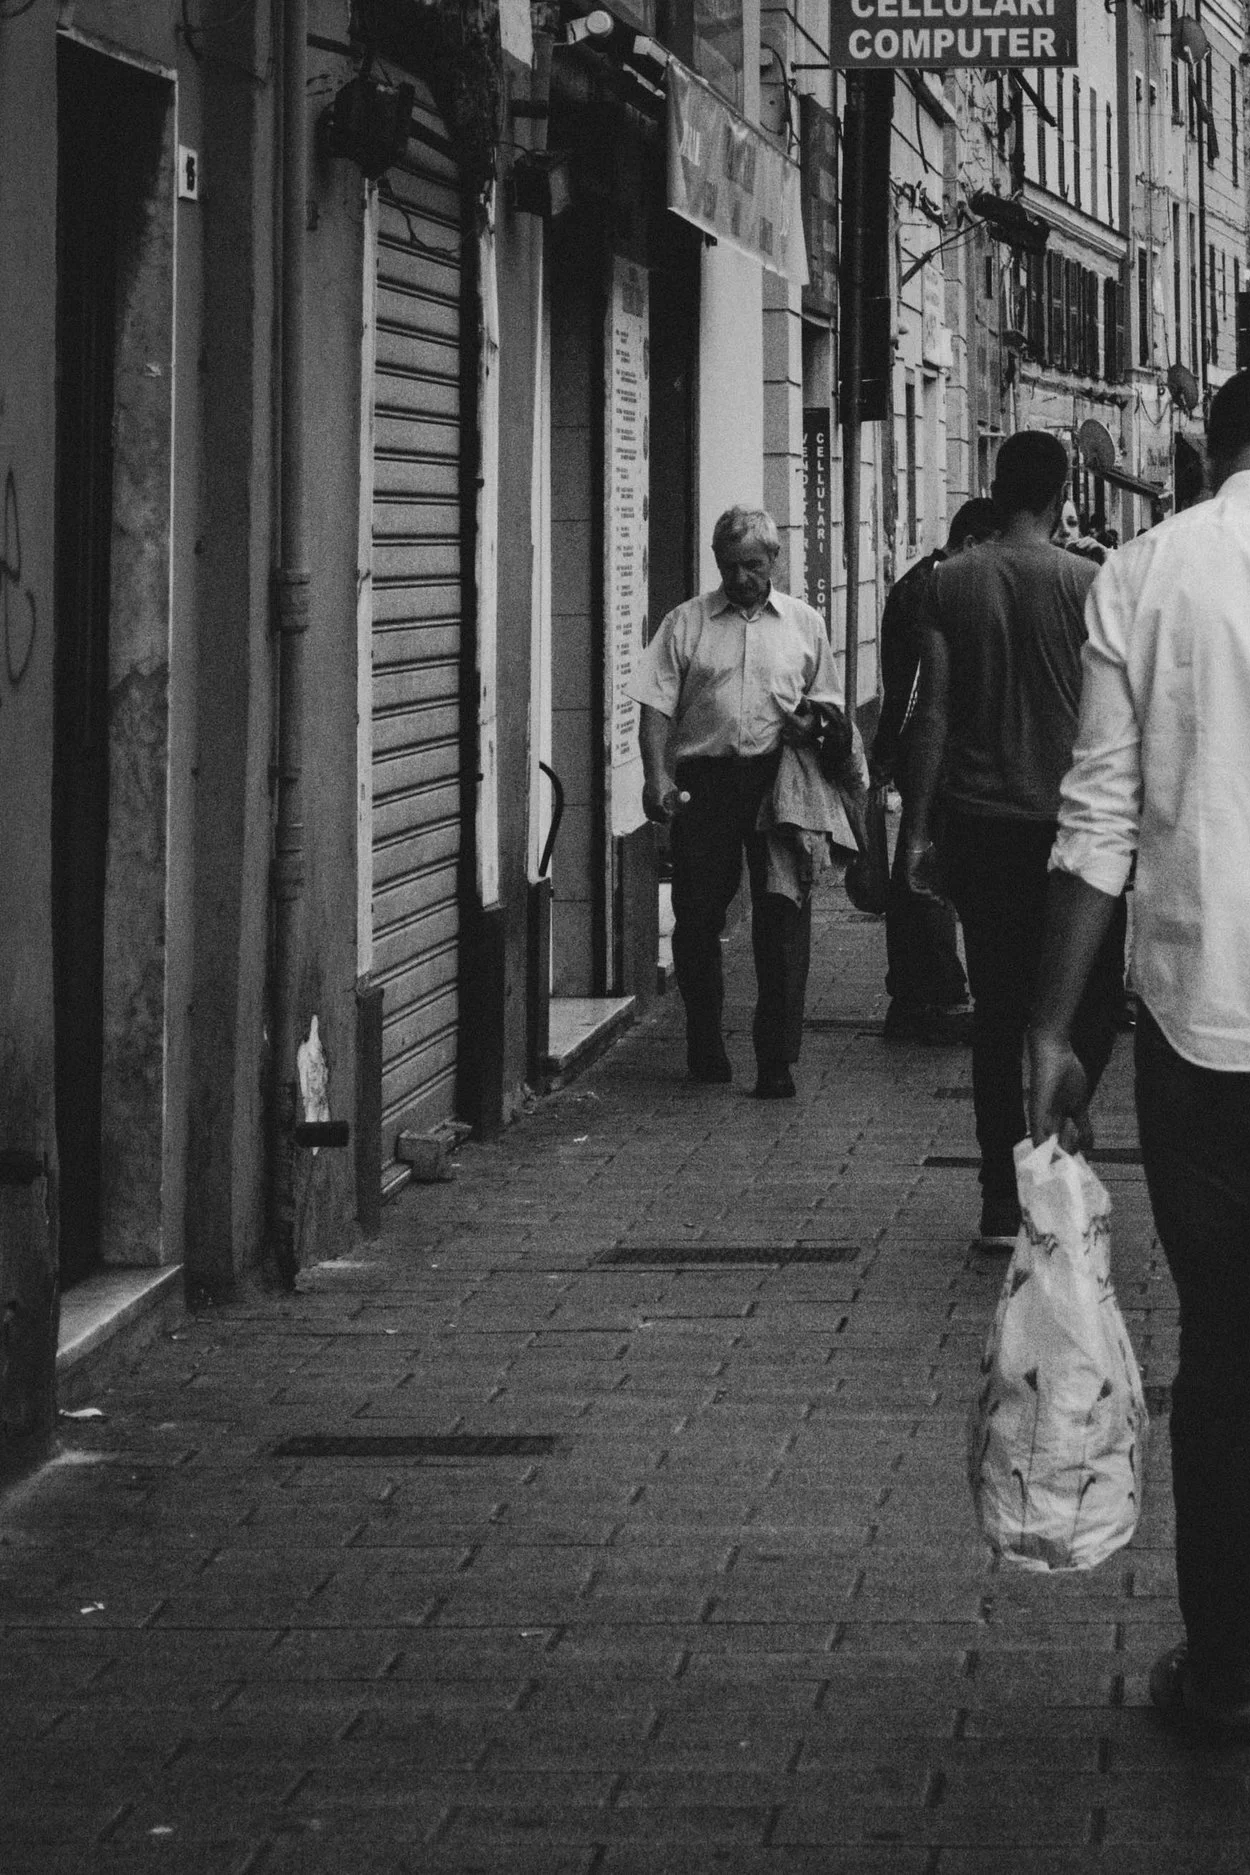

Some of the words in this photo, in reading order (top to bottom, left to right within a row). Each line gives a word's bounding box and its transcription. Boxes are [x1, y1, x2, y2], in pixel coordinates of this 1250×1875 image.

[849, 27, 1057, 59] COMPUTER
[816, 432, 826, 554] CELLULARI
[816, 578, 827, 618] COM
